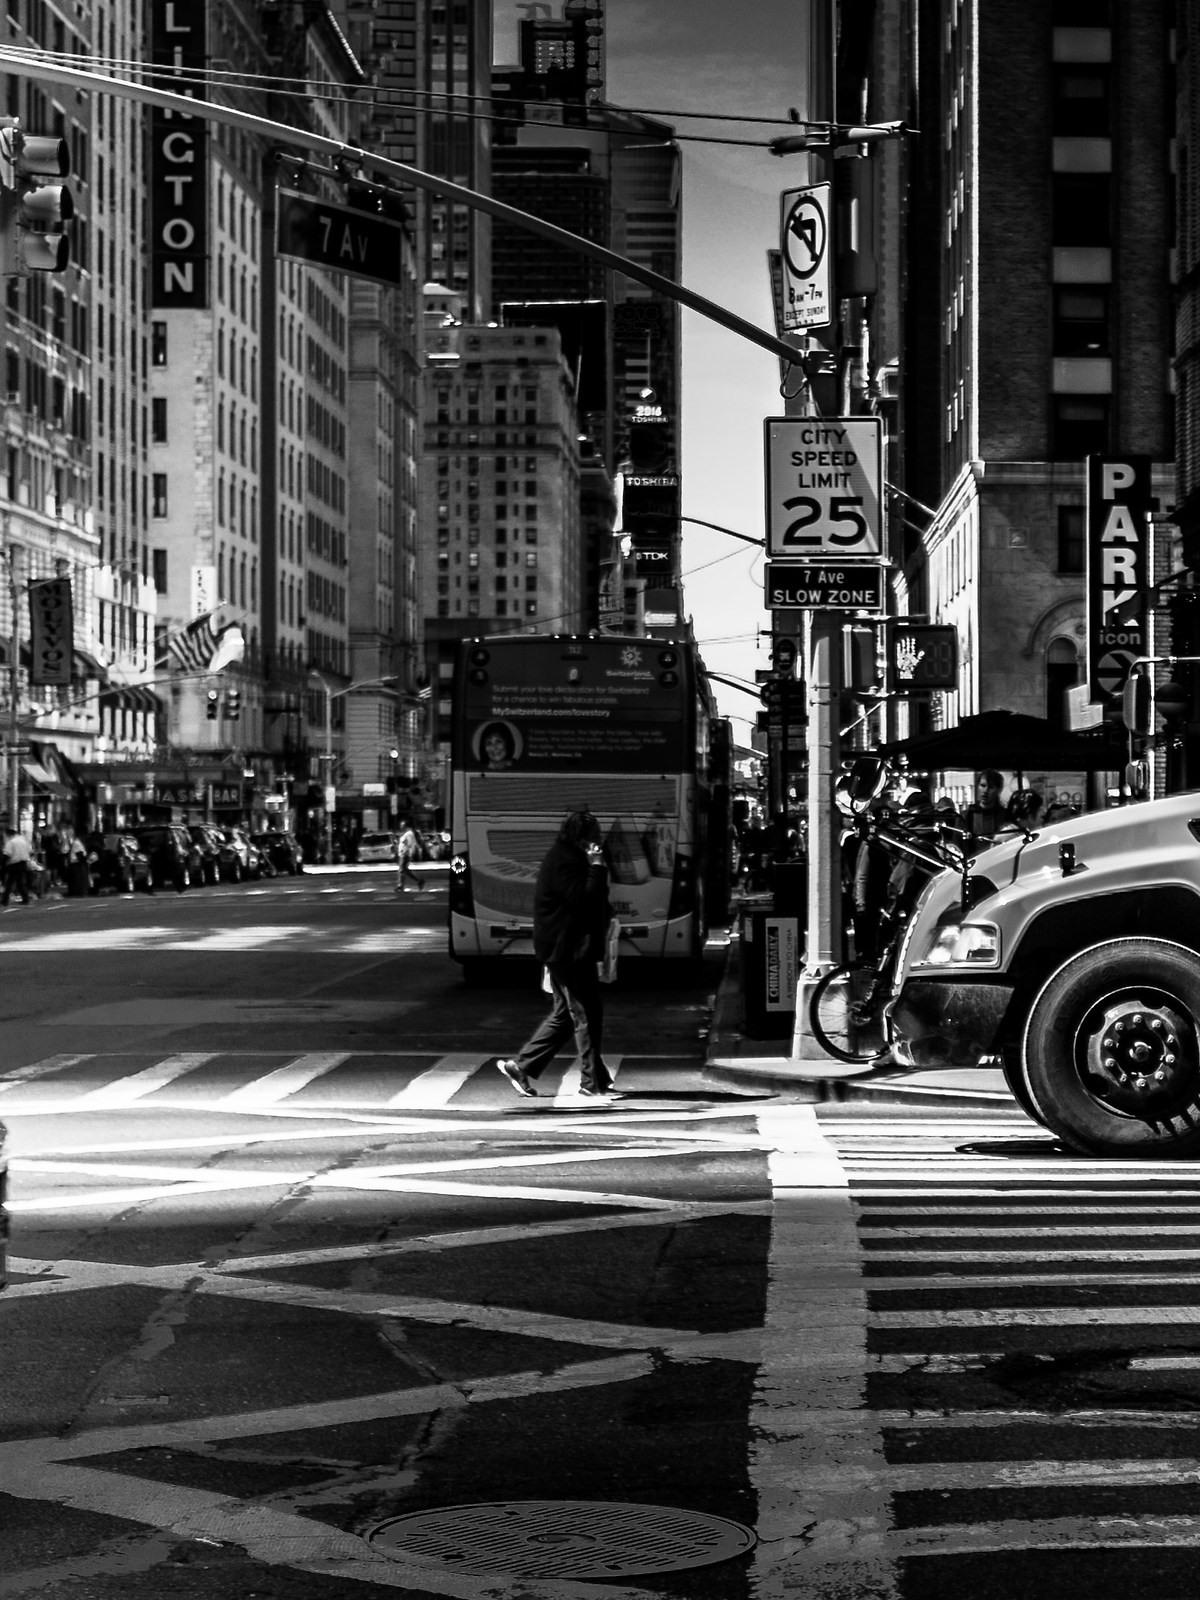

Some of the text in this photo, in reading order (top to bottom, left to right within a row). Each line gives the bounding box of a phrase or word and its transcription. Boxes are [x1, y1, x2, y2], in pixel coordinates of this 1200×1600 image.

[318, 215, 333, 253] 7
[785, 306, 826, 321] EXCEPT SUNDAY
[801, 429, 847, 445] CITY
[791, 451, 858, 466] SPEED
[626, 476, 678, 487] TOSHIBA
[799, 473, 852, 488] LIMIT
[782, 496, 868, 546] 25
[1100, 463, 1139, 626] PARK
[642, 552, 669, 560] TDK
[803, 570, 845, 584] 7 Ave
[772, 590, 876, 604] SLOW ZONE
[1099, 629, 1142, 645] icon
[608, 686, 650, 695] Switzerland
[214, 788, 239, 803] BAR
[786, 952, 793, 961] TO
